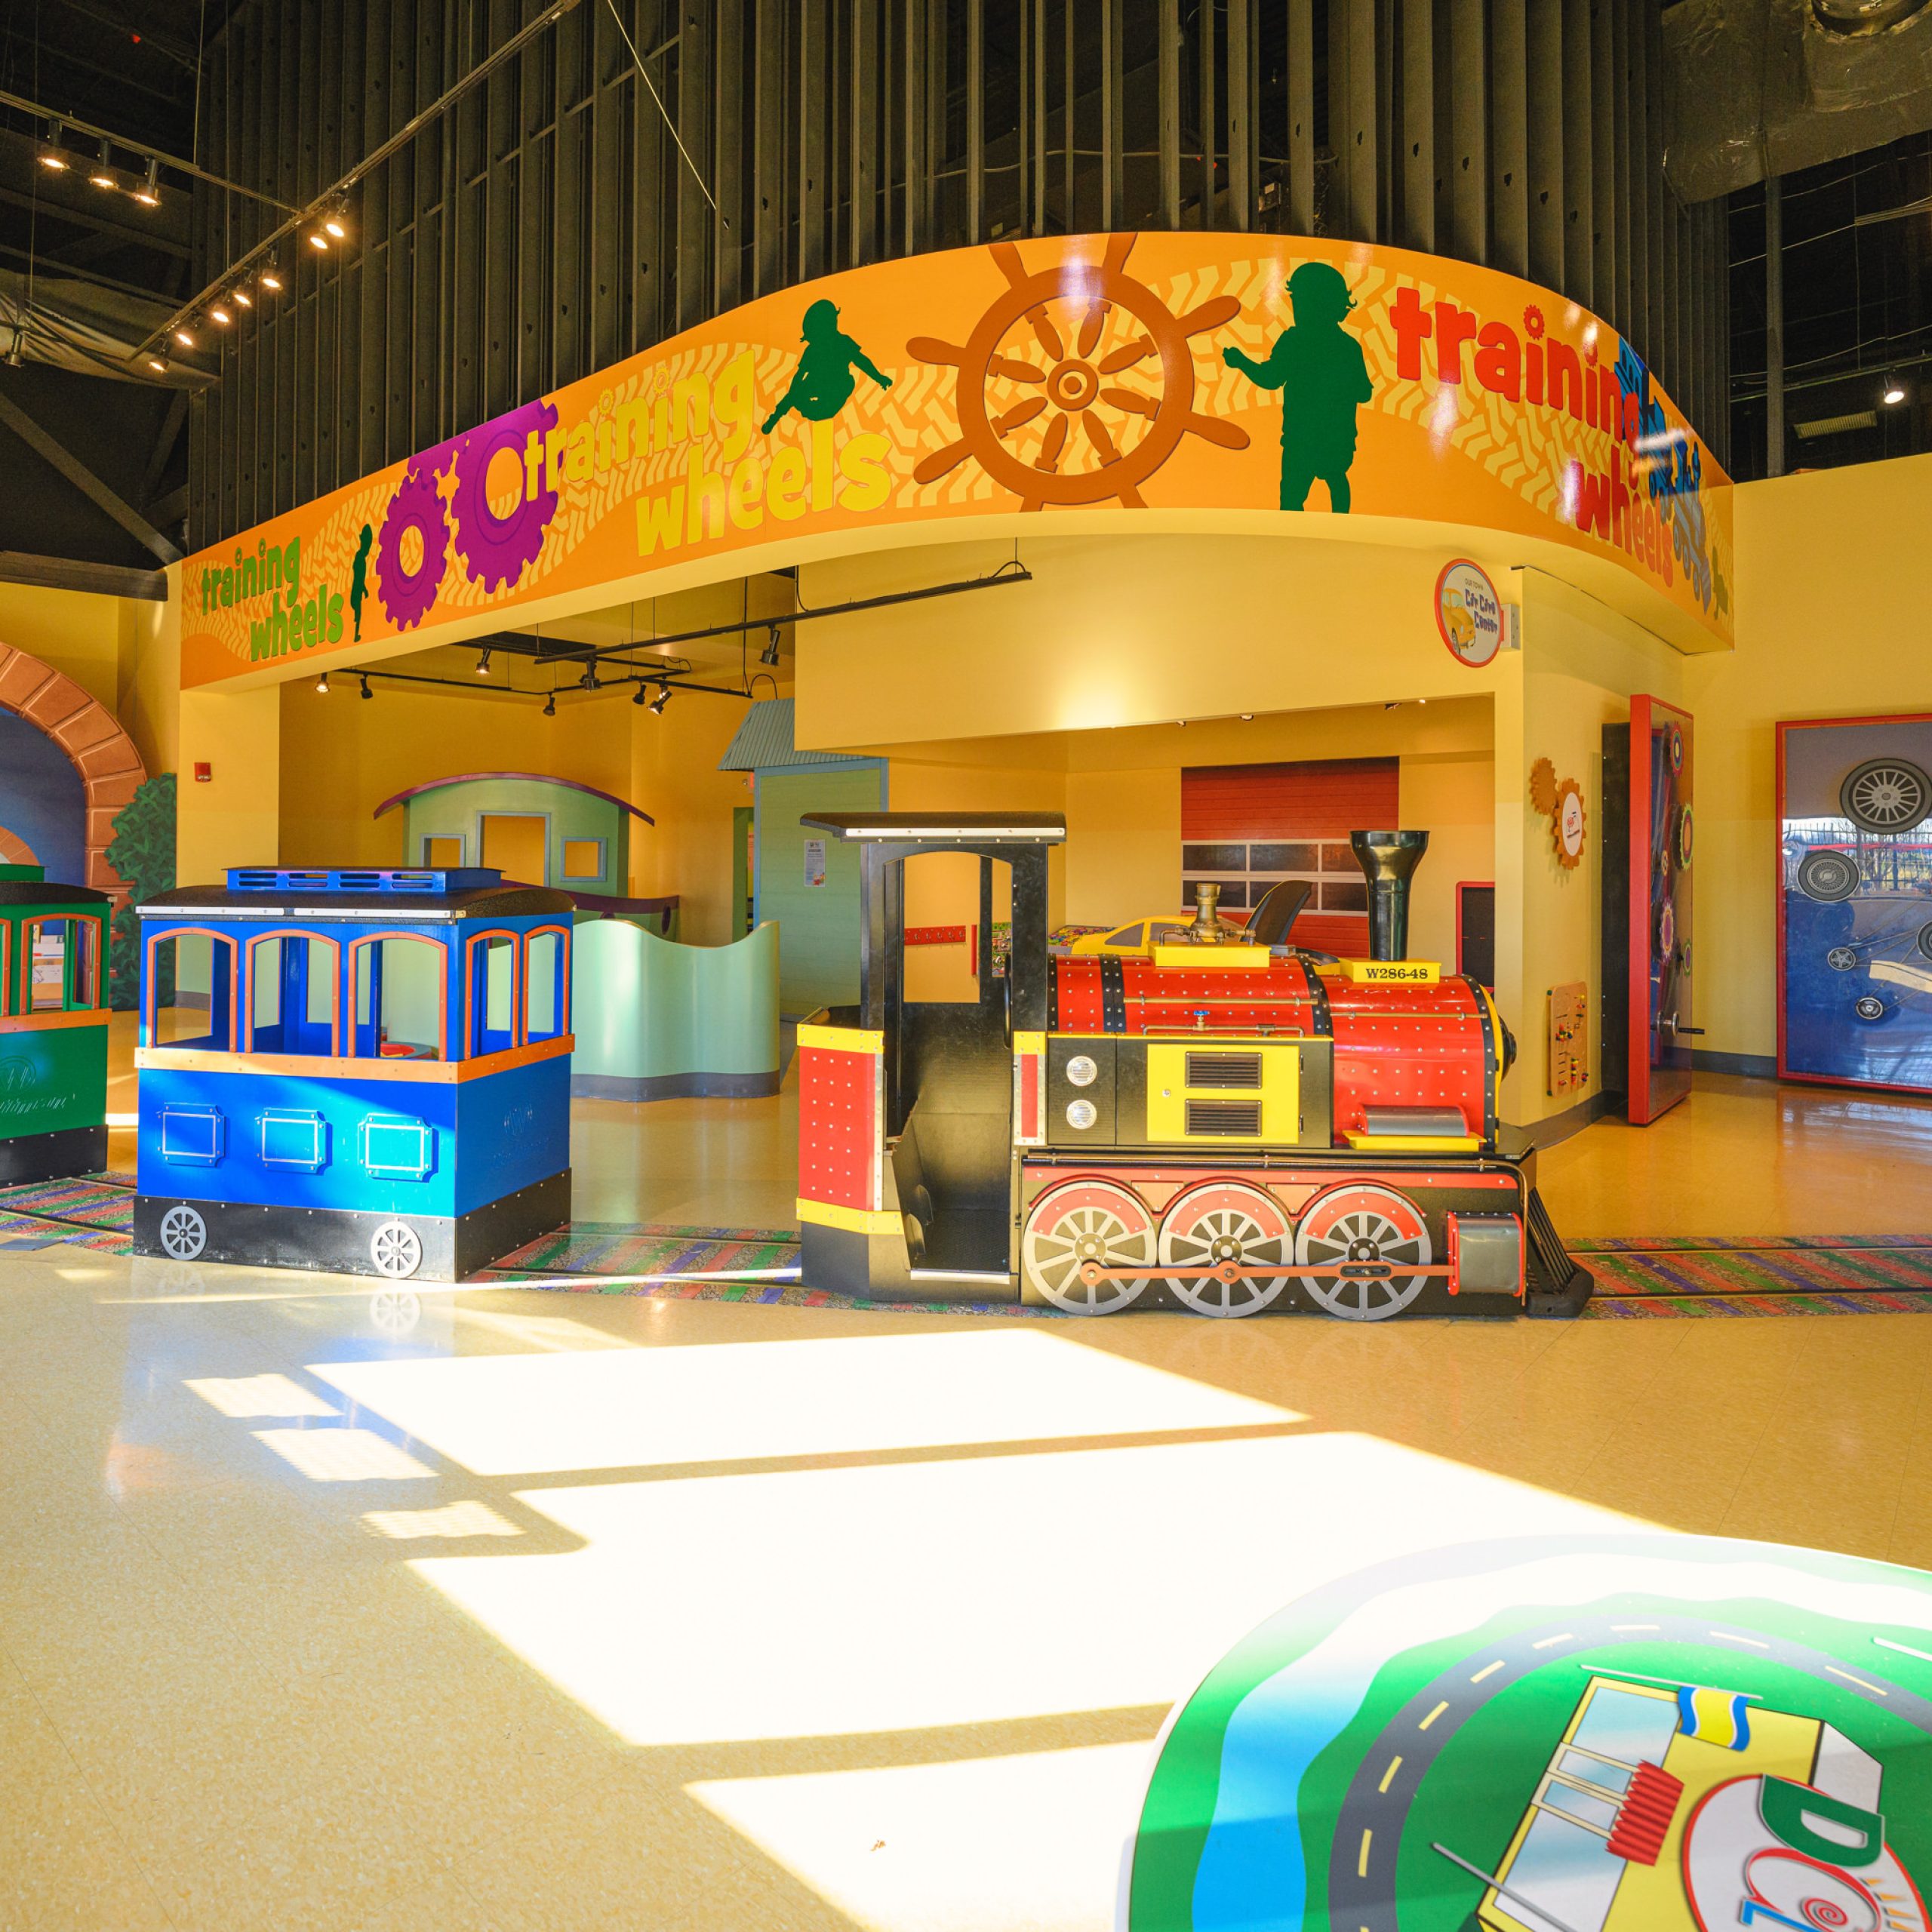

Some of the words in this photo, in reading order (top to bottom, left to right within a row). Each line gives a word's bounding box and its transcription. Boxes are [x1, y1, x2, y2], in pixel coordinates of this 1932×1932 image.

[524, 349, 755, 502] training
[1389, 286, 1641, 491] training
[635, 418, 893, 557] wheels
[1570, 445, 1674, 588] wheels
[202, 536, 300, 616] training
[250, 583, 345, 663] wheels
[1365, 968, 1429, 980] W286-48
